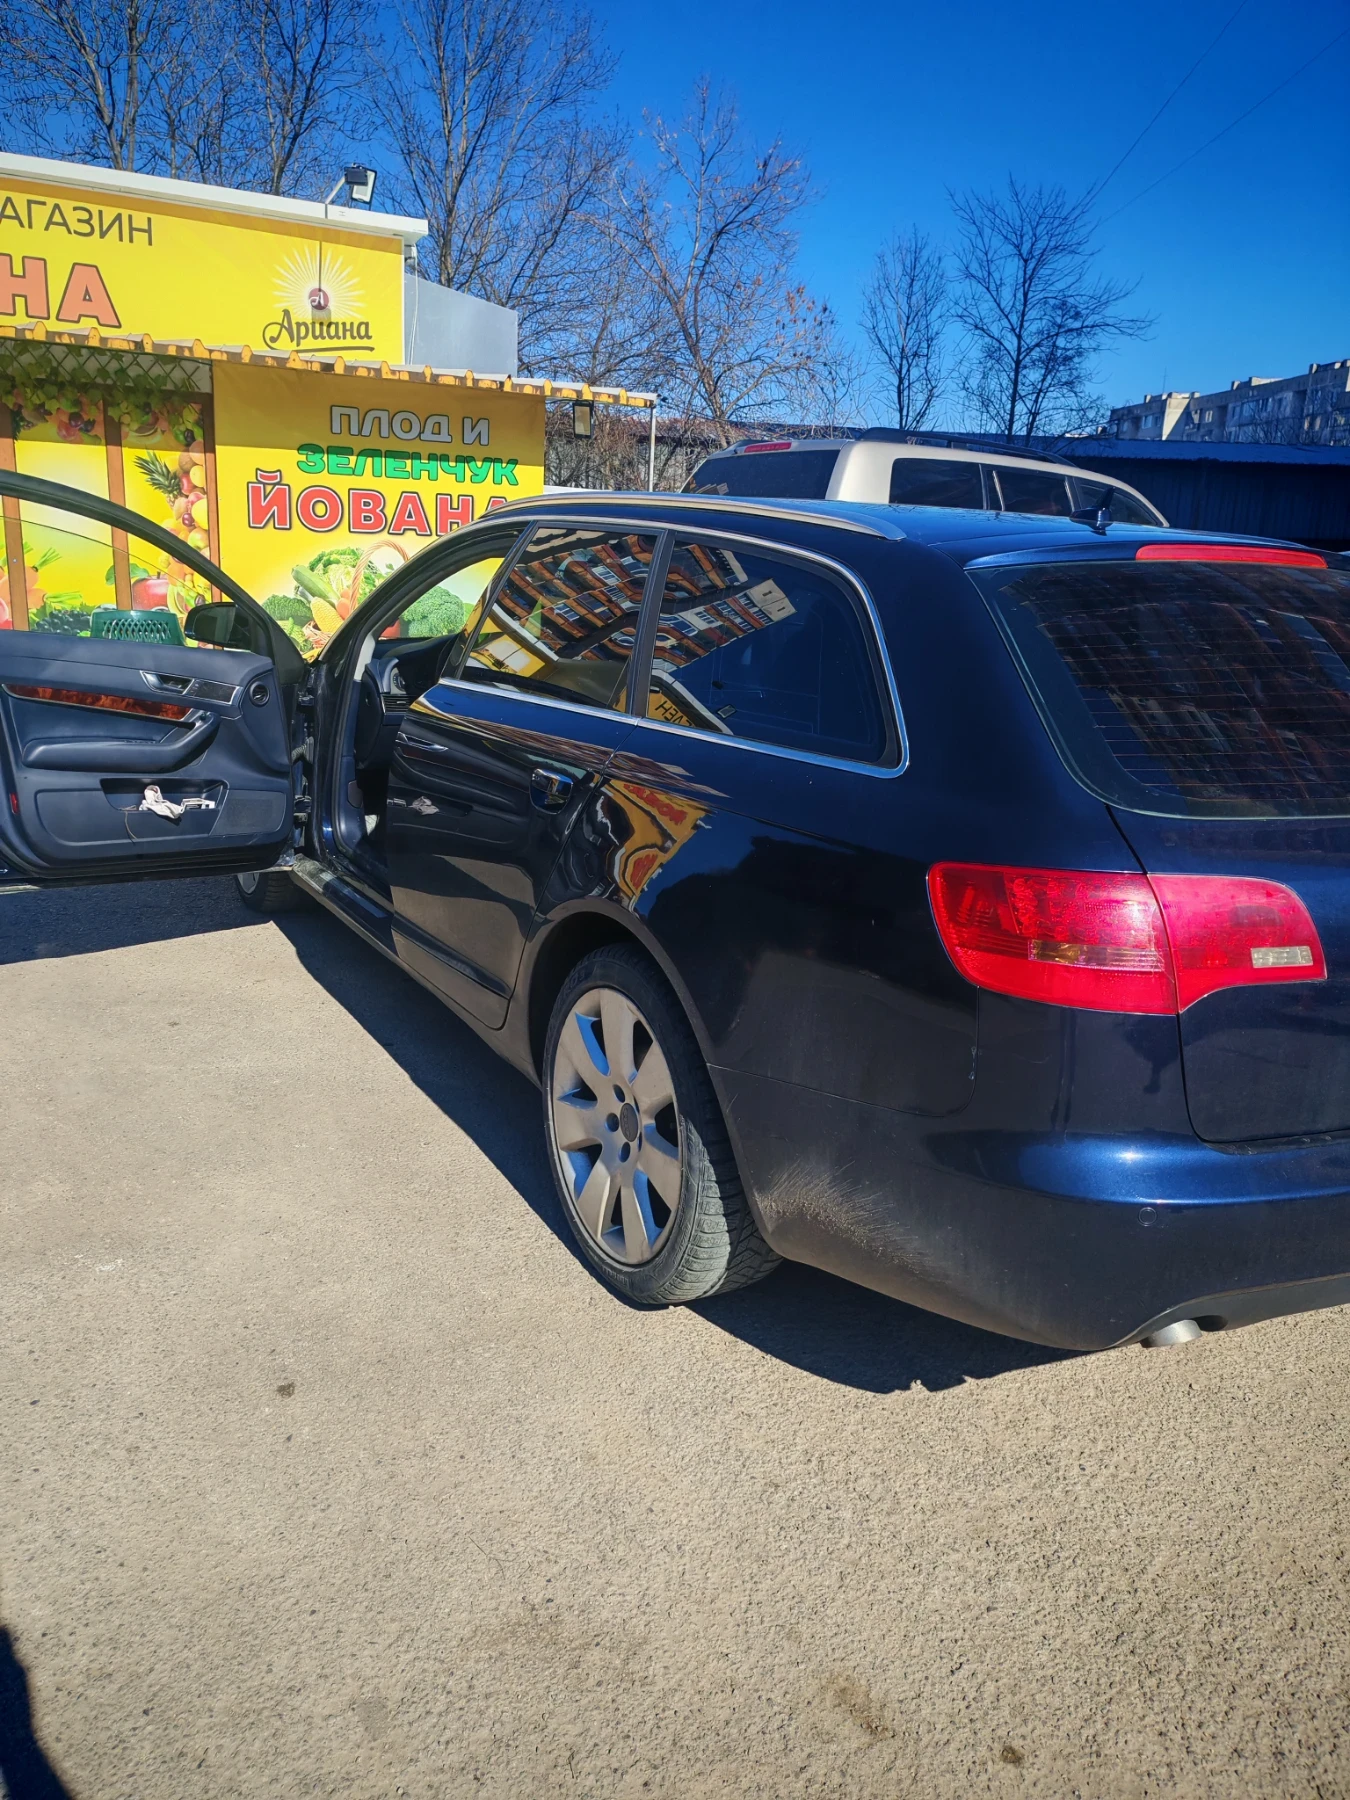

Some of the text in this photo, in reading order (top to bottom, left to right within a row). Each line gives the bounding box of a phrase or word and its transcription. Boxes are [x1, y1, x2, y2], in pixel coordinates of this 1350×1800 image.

[0, 196, 153, 246] АГАЗИН
[0, 252, 122, 329] НА
[263, 309, 373, 350] Ариана
[330, 405, 490, 446] ПЛОД И
[297, 443, 519, 486] ЗЕЛЕНЧУК
